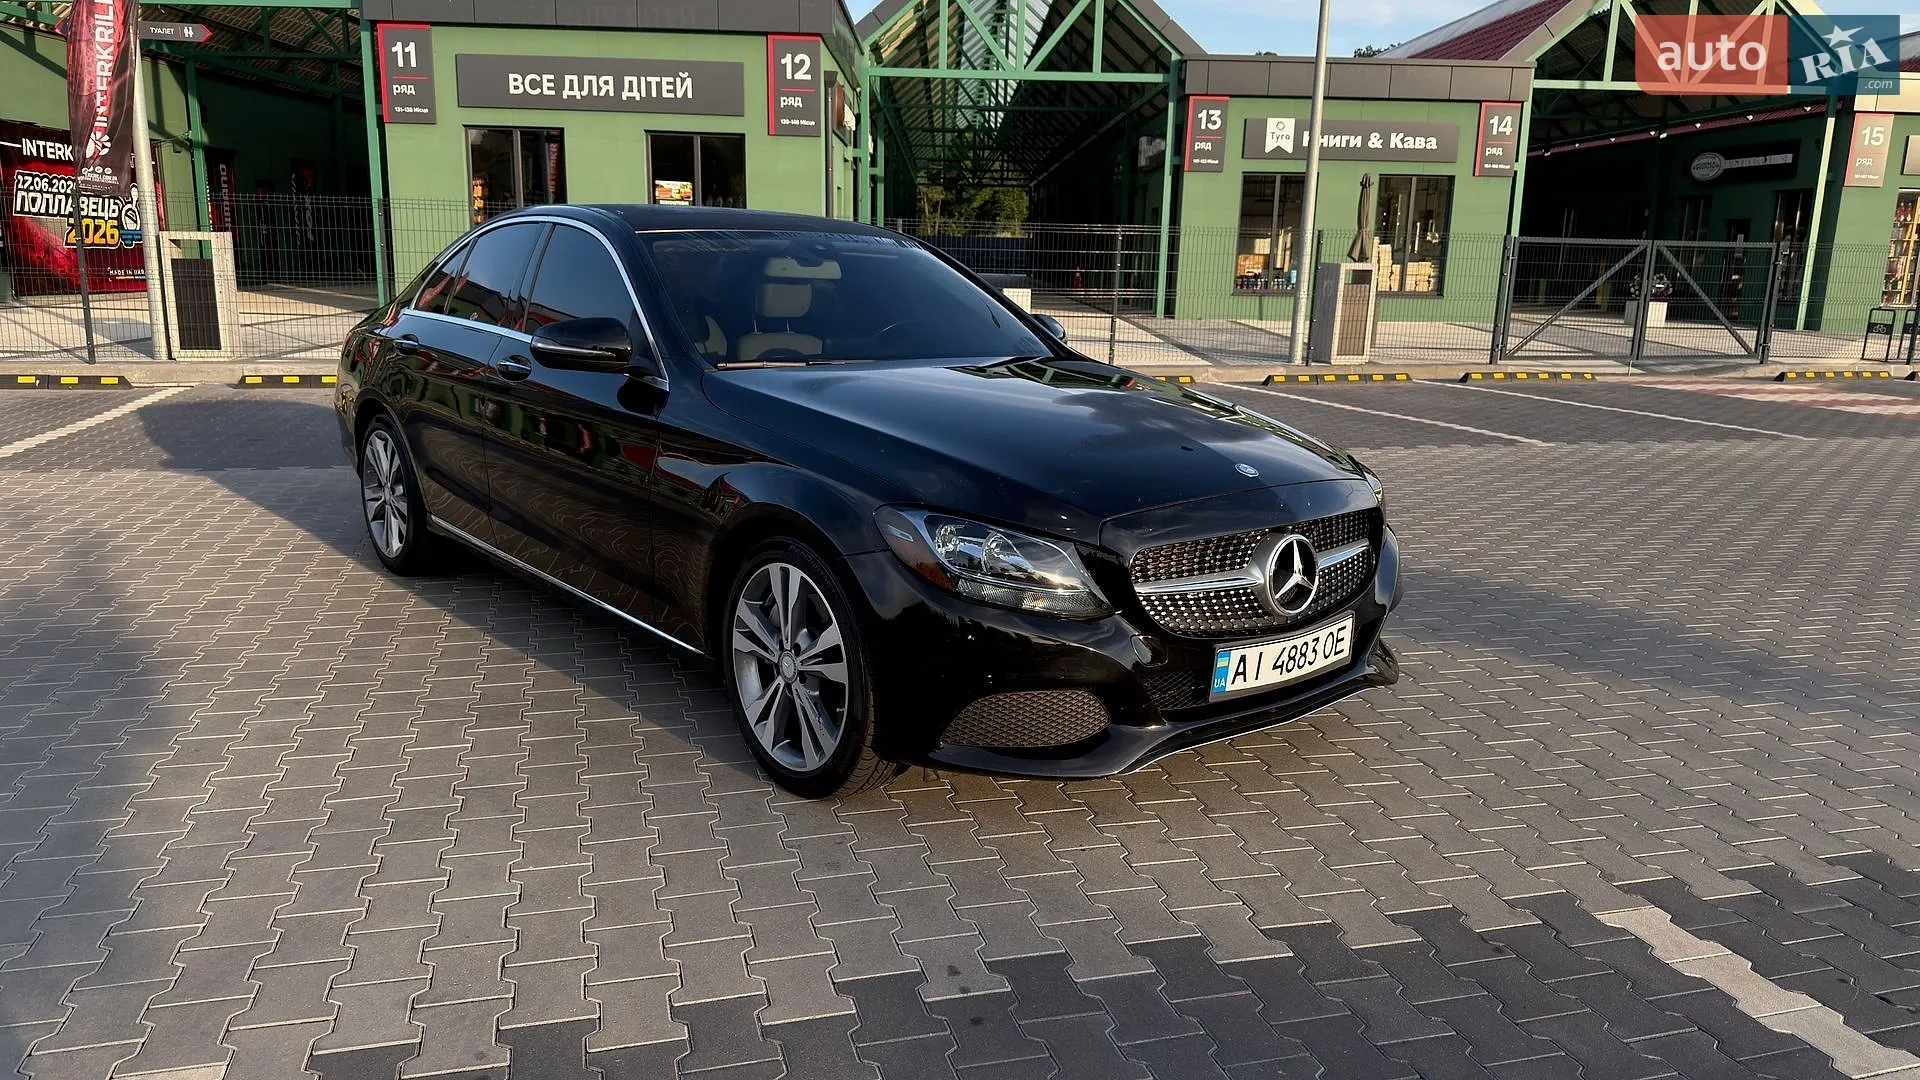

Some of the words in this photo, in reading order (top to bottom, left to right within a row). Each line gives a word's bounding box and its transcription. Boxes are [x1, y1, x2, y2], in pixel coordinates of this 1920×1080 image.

[150, 27, 175, 35] ТУАЛЕТ
[93, 0, 114, 128] INTERKRIL
[391, 41, 417, 68] 11
[781, 53, 812, 80] 12
[392, 84, 416, 96] ряд
[508, 73, 556, 96] ВСЕ
[562, 74, 615, 99] ДЛЯ
[621, 71, 693, 101] ДІТЕЙ
[780, 96, 803, 108] ряд
[1197, 109, 1222, 130] 13
[1489, 115, 1513, 136] 14
[1194, 141, 1212, 151] ряд
[1367, 132, 1384, 149] &
[1390, 132, 1438, 150] Кава
[1862, 126, 1885, 146] 15
[1485, 147, 1503, 157] ряд
[1855, 158, 1873, 167] ряд
[16, 174, 77, 194] 27.06.202
[67, 217, 119, 245] 2026
[1231, 652, 1263, 685] AI
[1272, 636, 1320, 676] 4883
[1323, 625, 1347, 660] OE
[1214, 676, 1226, 688] UA
